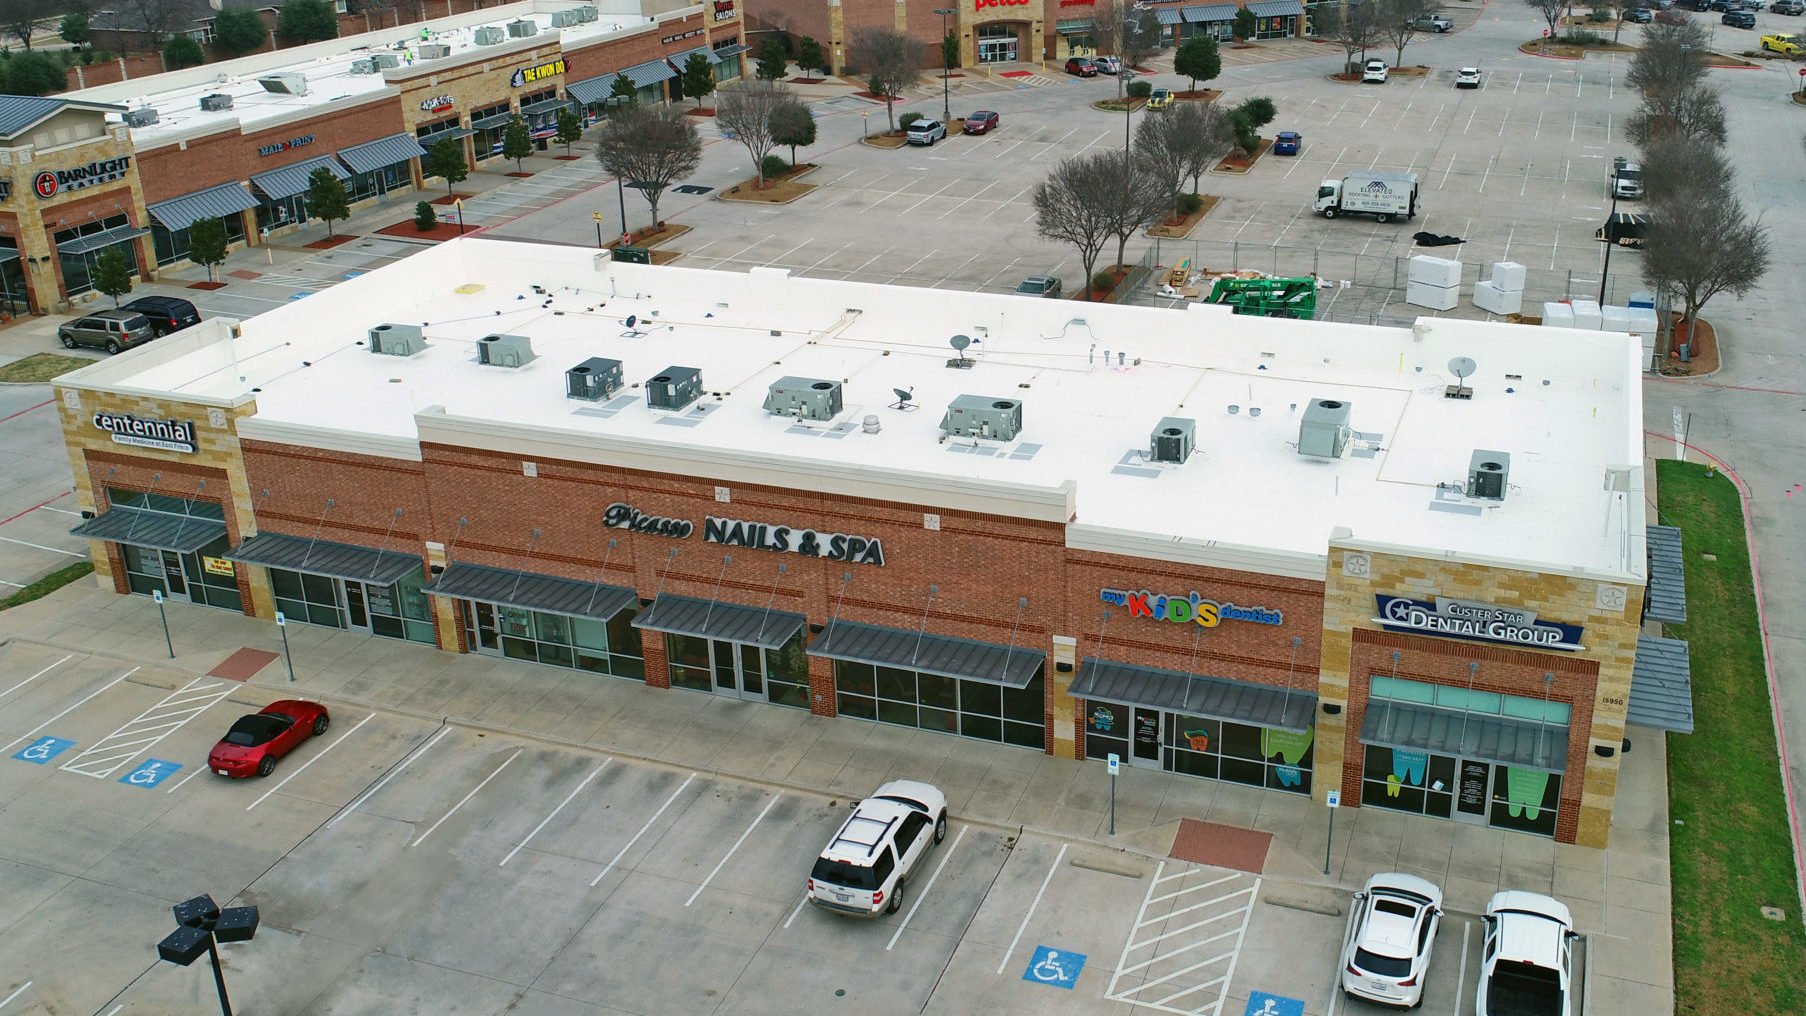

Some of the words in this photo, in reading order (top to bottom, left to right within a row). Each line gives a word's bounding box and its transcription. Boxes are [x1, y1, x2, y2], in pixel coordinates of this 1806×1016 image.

[715, 9, 736, 21] SALONS
[523, 68, 536, 82] TAE
[536, 63, 555, 79] KWON
[555, 60, 565, 74] DO
[259, 143, 284, 156] MAIL
[290, 133, 315, 148] PRINT
[67, 171, 127, 190] EATERY
[92, 413, 192, 441] centennial
[114, 435, 132, 444] Family
[132, 437, 154, 447] Medicine
[603, 503, 692, 538] Picasso
[703, 515, 790, 552] NAILS
[798, 529, 820, 557] &
[828, 533, 885, 566] SPA
[1101, 589, 1125, 606] my
[1220, 603, 1283, 626] dentist
[1448, 604, 1491, 619] CUSTER
[1495, 610, 1524, 624] STAR
[1410, 611, 1485, 636] DENTAL
[1488, 621, 1561, 645] GROUP
[1602, 696, 1624, 706] 15950
